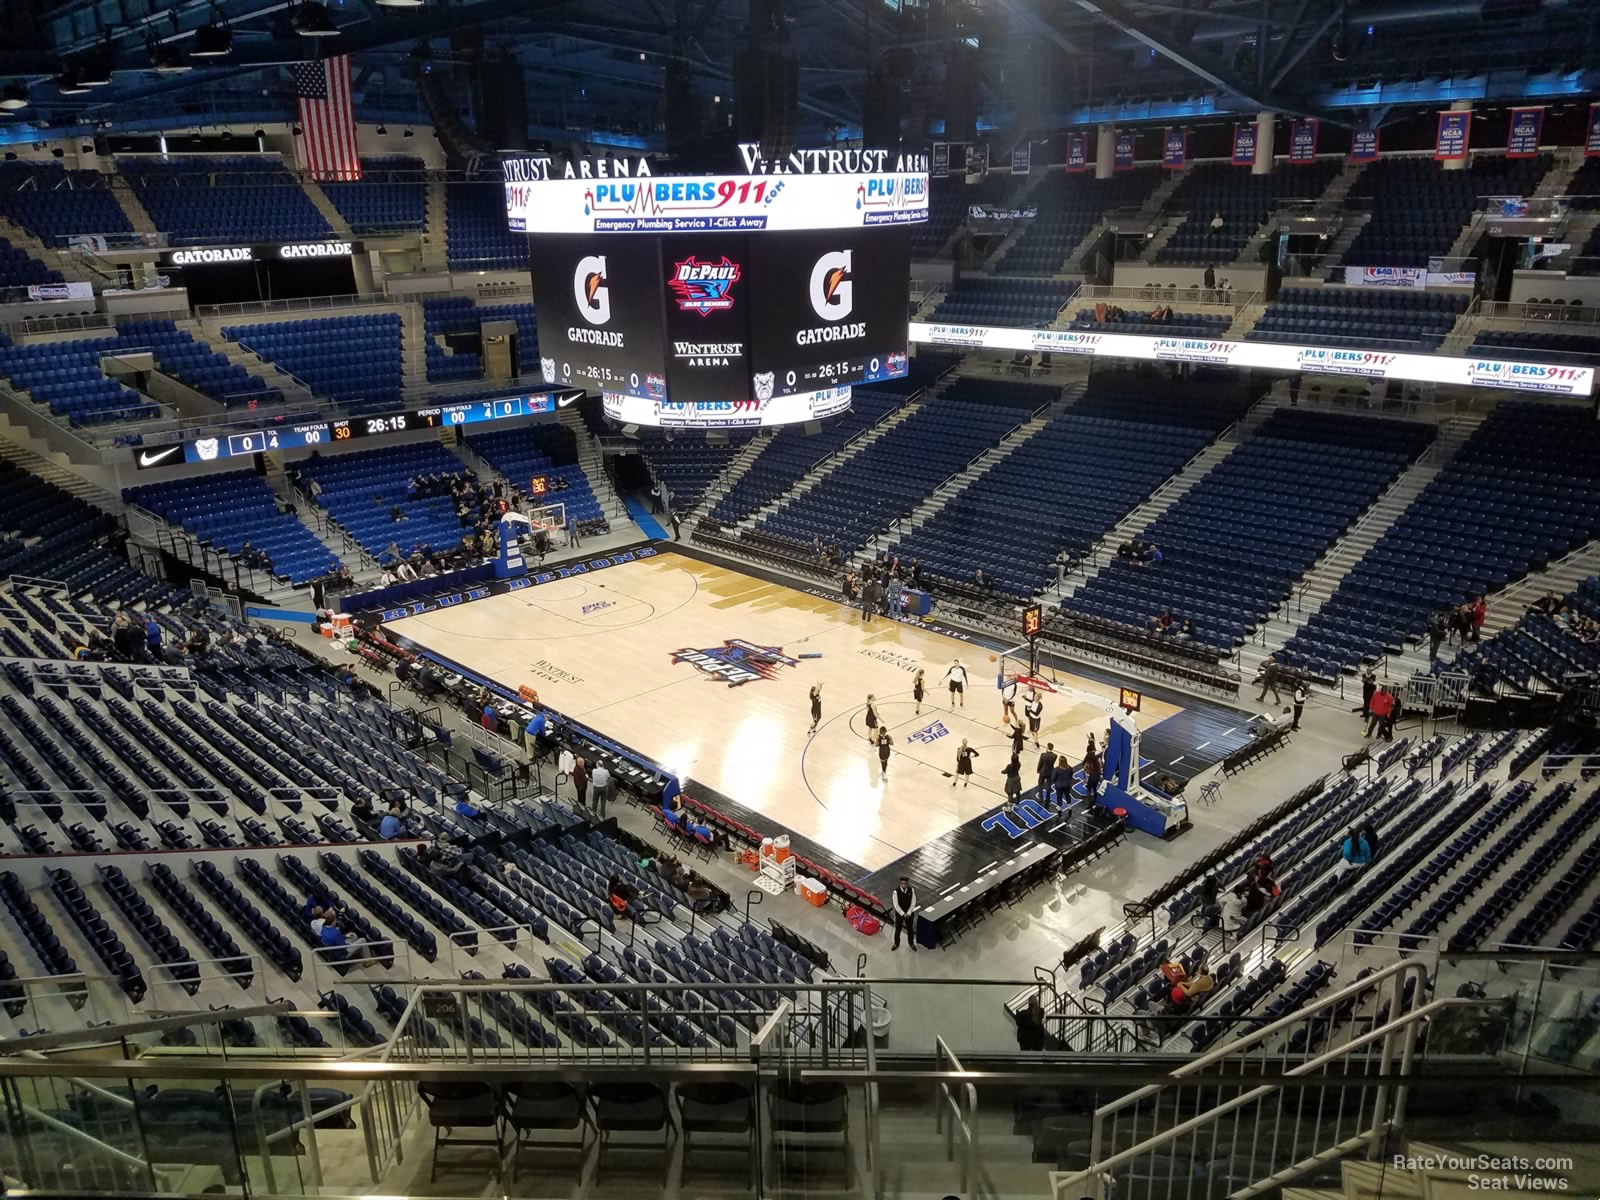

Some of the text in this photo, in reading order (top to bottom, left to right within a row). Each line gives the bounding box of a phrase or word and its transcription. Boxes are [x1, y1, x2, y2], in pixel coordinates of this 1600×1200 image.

[564, 157, 651, 178] ARENA
[596, 217, 764, 231] Emergency Plumbing Service 1-Click Away
[865, 213, 893, 223] Emergency
[172, 248, 252, 264] GATORADE
[280, 243, 352, 258] GATORADE
[574, 255, 611, 325] G
[809, 249, 853, 321] G
[568, 327, 624, 348] GATORADE
[796, 322, 866, 345] GATORADE
[673, 342, 743, 355] WINTRUST
[689, 358, 729, 366] ARENA
[870, 357, 879, 373] 0
[563, 362, 571, 377] 0
[587, 365, 612, 380] 26:15
[818, 362, 849, 378] 26:15
[630, 373, 639, 388] 0
[786, 370, 796, 386] 0
[1472, 378, 1498, 386] Emergency
[418, 408, 440, 417] PERIOD
[442, 404, 472, 413] TEAM FOULS
[484, 407, 492, 418] 4
[504, 402, 512, 414] 0
[367, 416, 406, 433] 26:15
[427, 416, 433, 427] 1
[451, 412, 465, 423] 00
[294, 423, 328, 433] TEAM FOULS
[335, 427, 350, 439] 30
[242, 437, 253, 450] 0
[269, 436, 279, 448] 4
[305, 431, 320, 443] 00
[382, 587, 491, 622] BLUE
[507, 548, 657, 592] DEMONS
[943, 629, 971, 641] RAY
[857, 648, 918, 673] WINTRUST
[881, 649, 917, 663] ARENA
[530, 669, 559, 684] ARENA
[906, 722, 945, 744] EAST
[921, 727, 950, 745] BIG
[436, 1004, 455, 1013] 206
